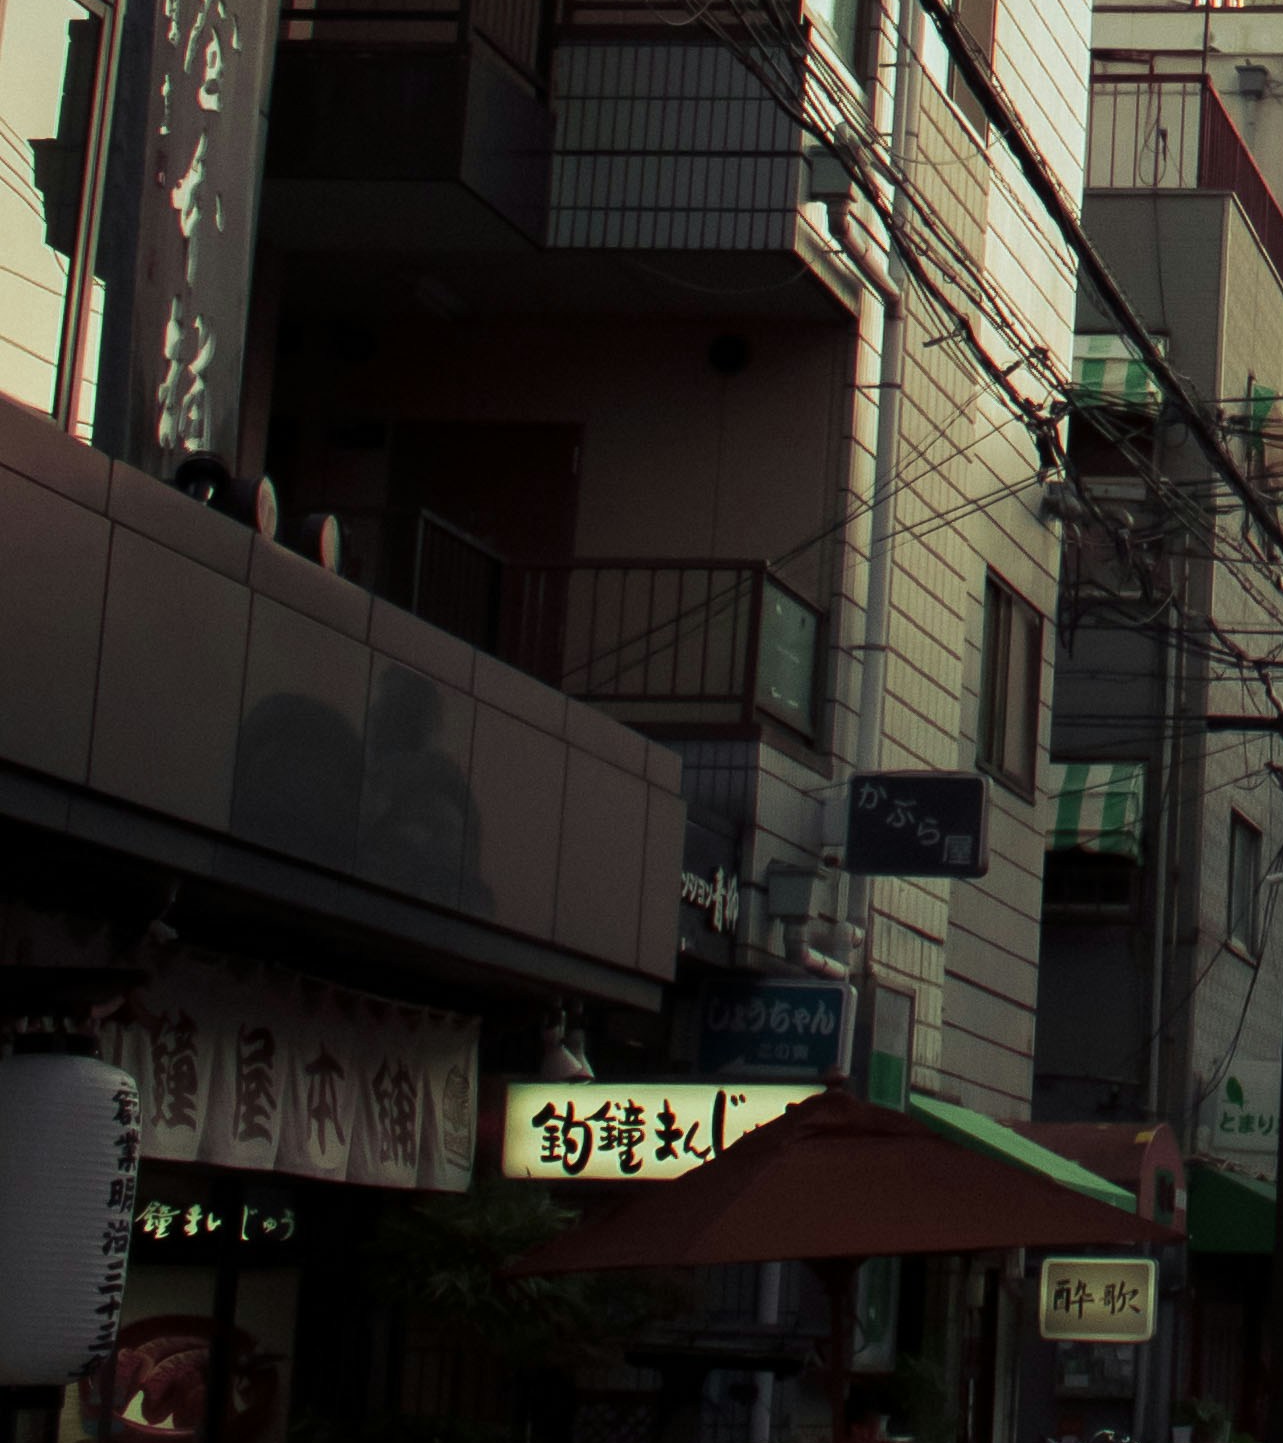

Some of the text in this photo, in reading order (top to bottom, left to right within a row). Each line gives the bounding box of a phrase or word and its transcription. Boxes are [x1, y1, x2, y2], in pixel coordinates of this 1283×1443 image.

[857, 781, 974, 865] かぶら屋
[531, 1089, 798, 1177] 釣鐘まんじ
[1218, 1112, 1282, 1135] とまり
